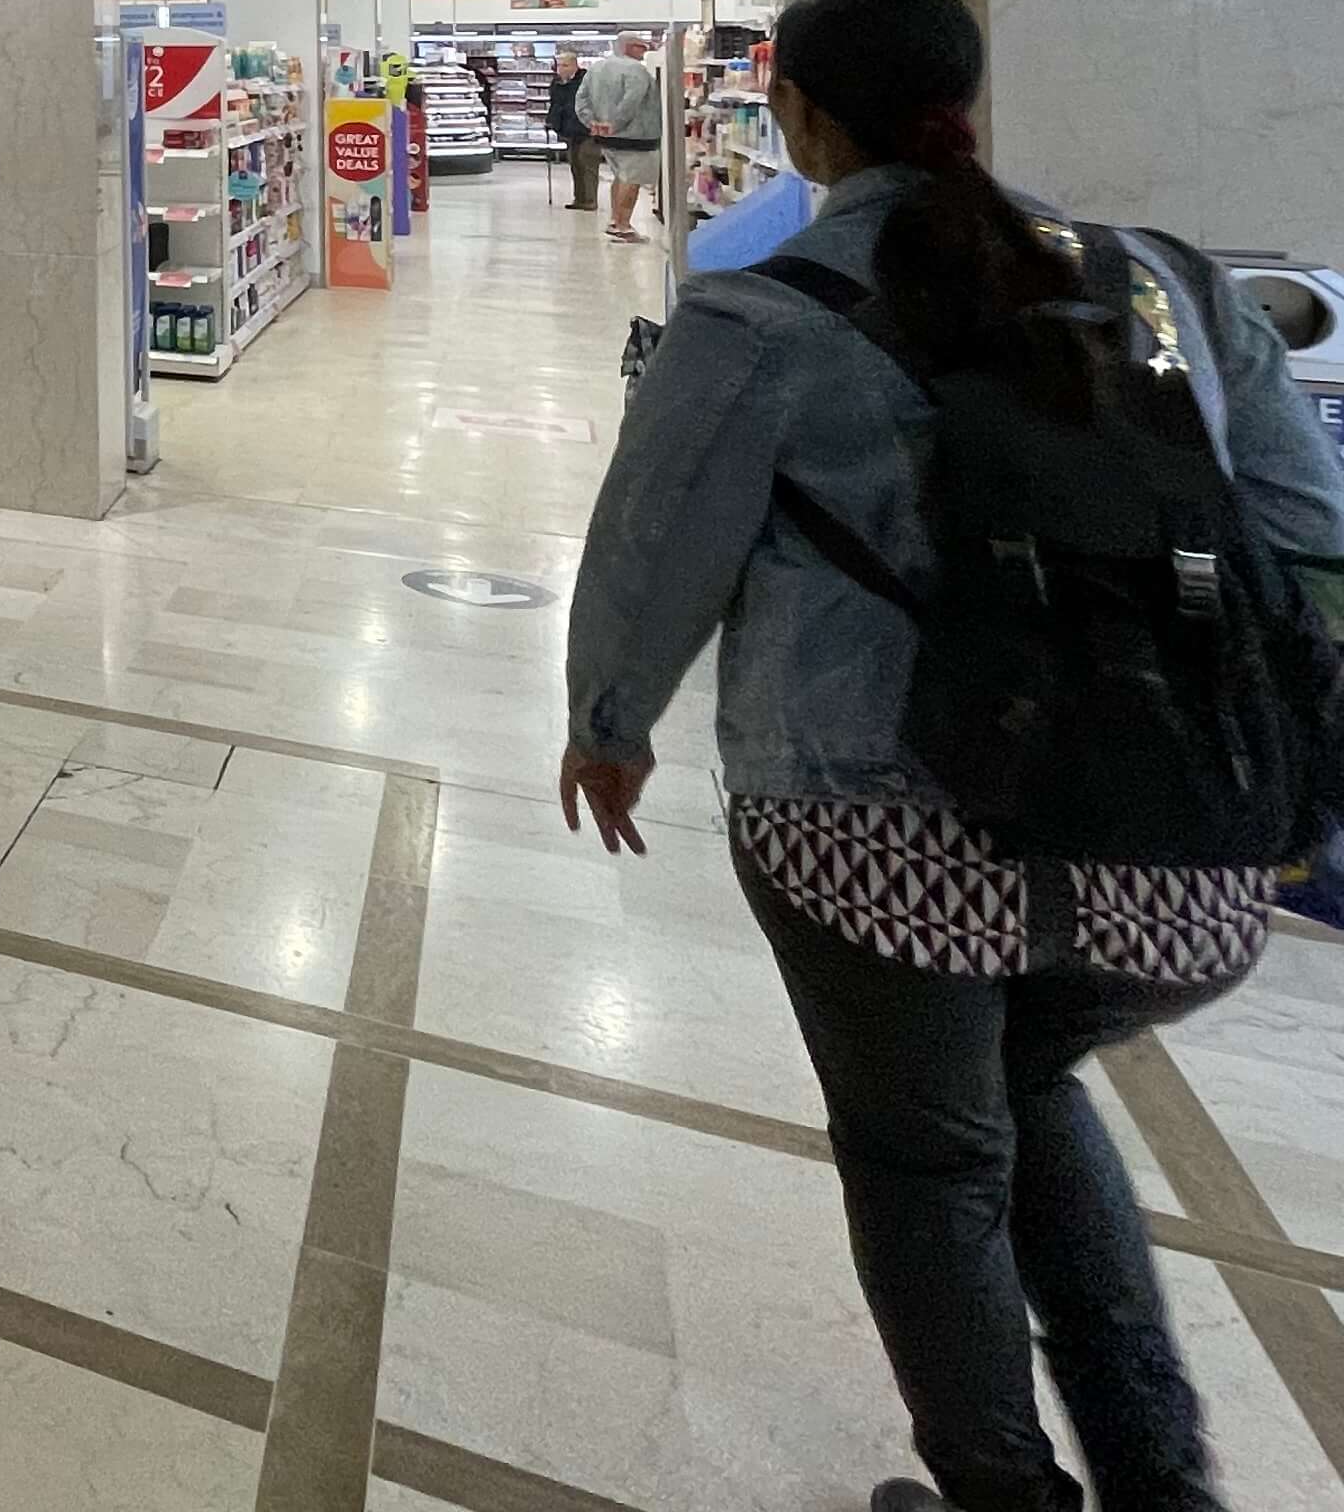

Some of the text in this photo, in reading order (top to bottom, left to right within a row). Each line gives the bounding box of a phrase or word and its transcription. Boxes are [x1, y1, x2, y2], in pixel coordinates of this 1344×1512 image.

[335, 133, 380, 146] GREAT
[335, 146, 379, 158] VALUE
[336, 159, 379, 170] DEALS
